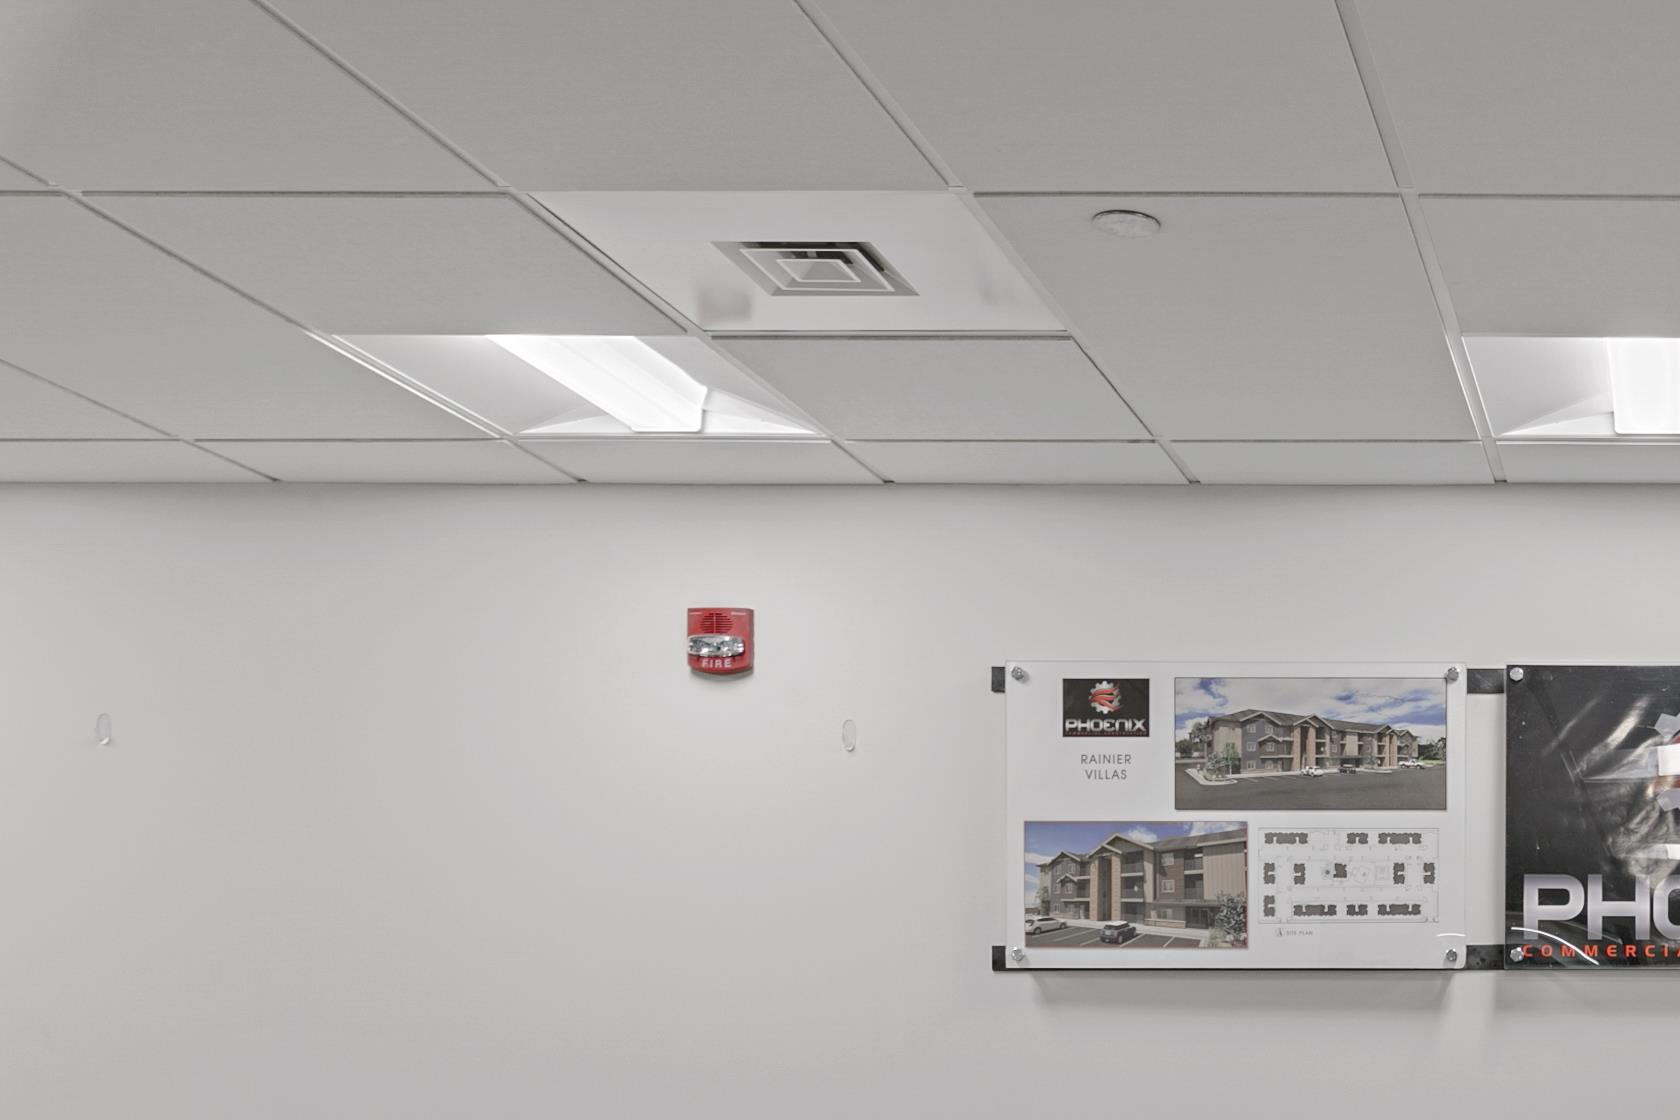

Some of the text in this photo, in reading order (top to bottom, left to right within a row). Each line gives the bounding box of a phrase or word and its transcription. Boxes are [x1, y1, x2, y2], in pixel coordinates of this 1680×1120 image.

[702, 659, 731, 668] FIRE
[1065, 719, 1146, 731] PHOENIX
[1080, 754, 1132, 765] RAINIER
[1085, 769, 1128, 780] VILLAS
